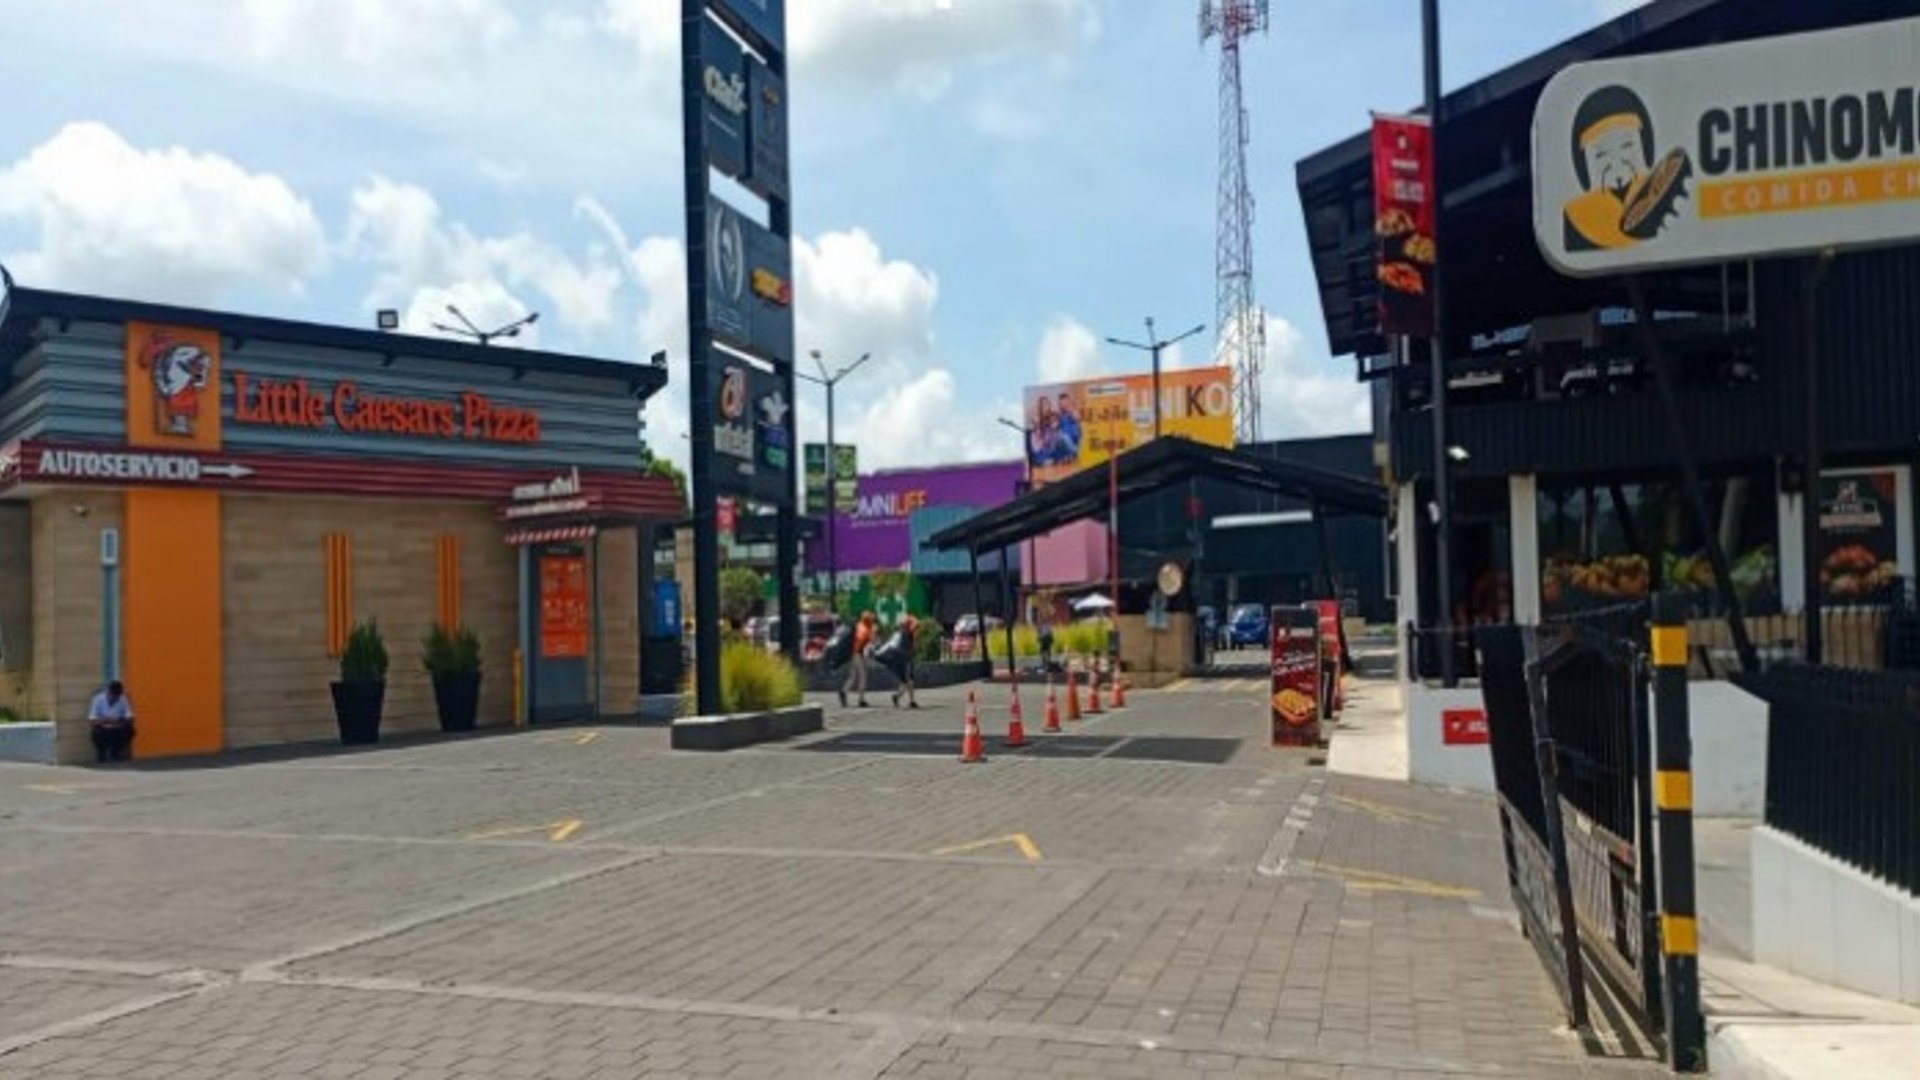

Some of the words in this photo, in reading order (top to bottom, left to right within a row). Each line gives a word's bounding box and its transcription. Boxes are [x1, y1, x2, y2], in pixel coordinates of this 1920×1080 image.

[1698, 87, 1920, 175] CHINOM
[1722, 175, 1858, 210] COMIDA
[234, 370, 325, 428] Little
[331, 376, 456, 437] Caesars
[462, 387, 540, 442] Pizza
[1129, 382, 1230, 420] UNIKO
[38, 450, 200, 480] AUTOSERVICIO
[851, 490, 926, 518] MNILIFE
